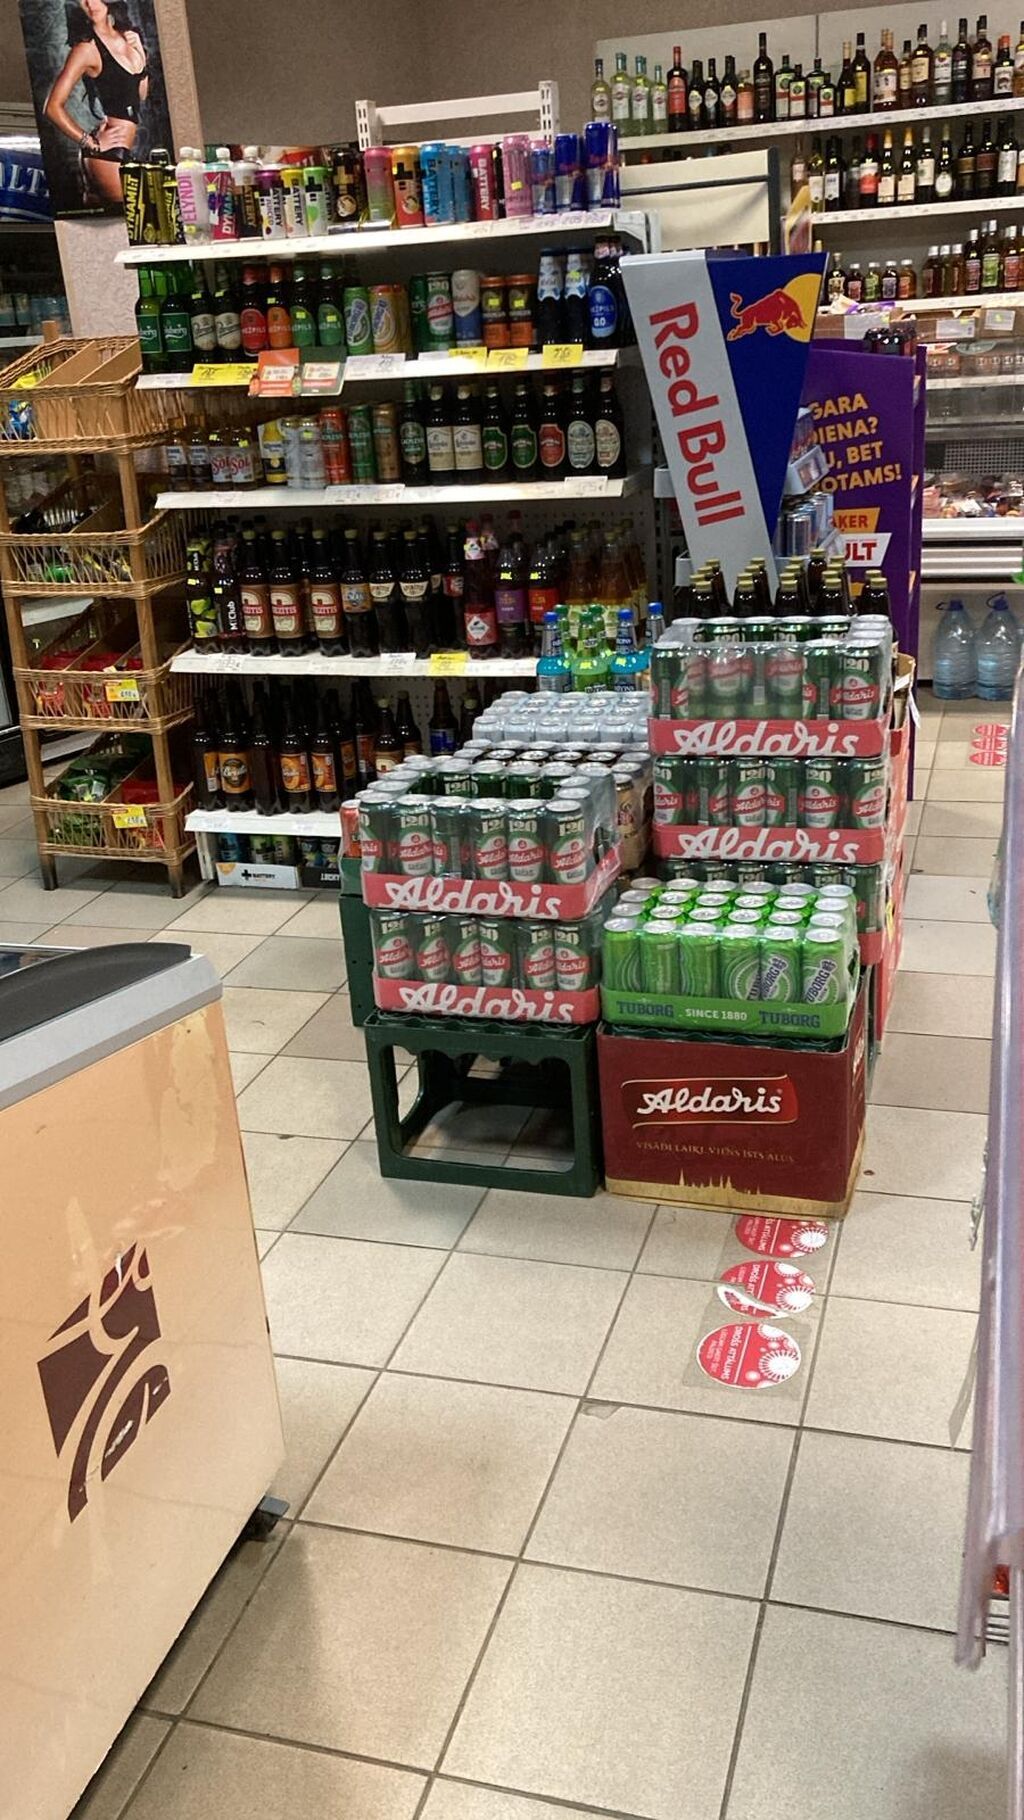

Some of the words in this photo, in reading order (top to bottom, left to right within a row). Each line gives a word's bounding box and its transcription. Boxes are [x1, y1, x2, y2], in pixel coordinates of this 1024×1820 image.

[291, 178, 304, 225] BATTERY
[477, 158, 490, 210] BATTERY
[649, 302, 719, 417] Red
[808, 392, 869, 421] GARA
[847, 440, 883, 464] BET
[677, 420, 746, 527] Bull
[665, 721, 860, 757] Aldaris
[401, 814, 429, 828] 120
[509, 820, 537, 833] 120
[669, 828, 860, 863] Aldaris
[379, 876, 563, 918] Aldaris
[389, 983, 575, 1023] Aldaris
[616, 1001, 674, 1018] TUBORG
[685, 1008, 719, 1019] SINCE
[722, 1010, 747, 1021] 1880
[759, 1010, 821, 1028] TUBORG
[636, 1086, 783, 1115] Aldaris
[730, 1326, 744, 1351] DROŠS
